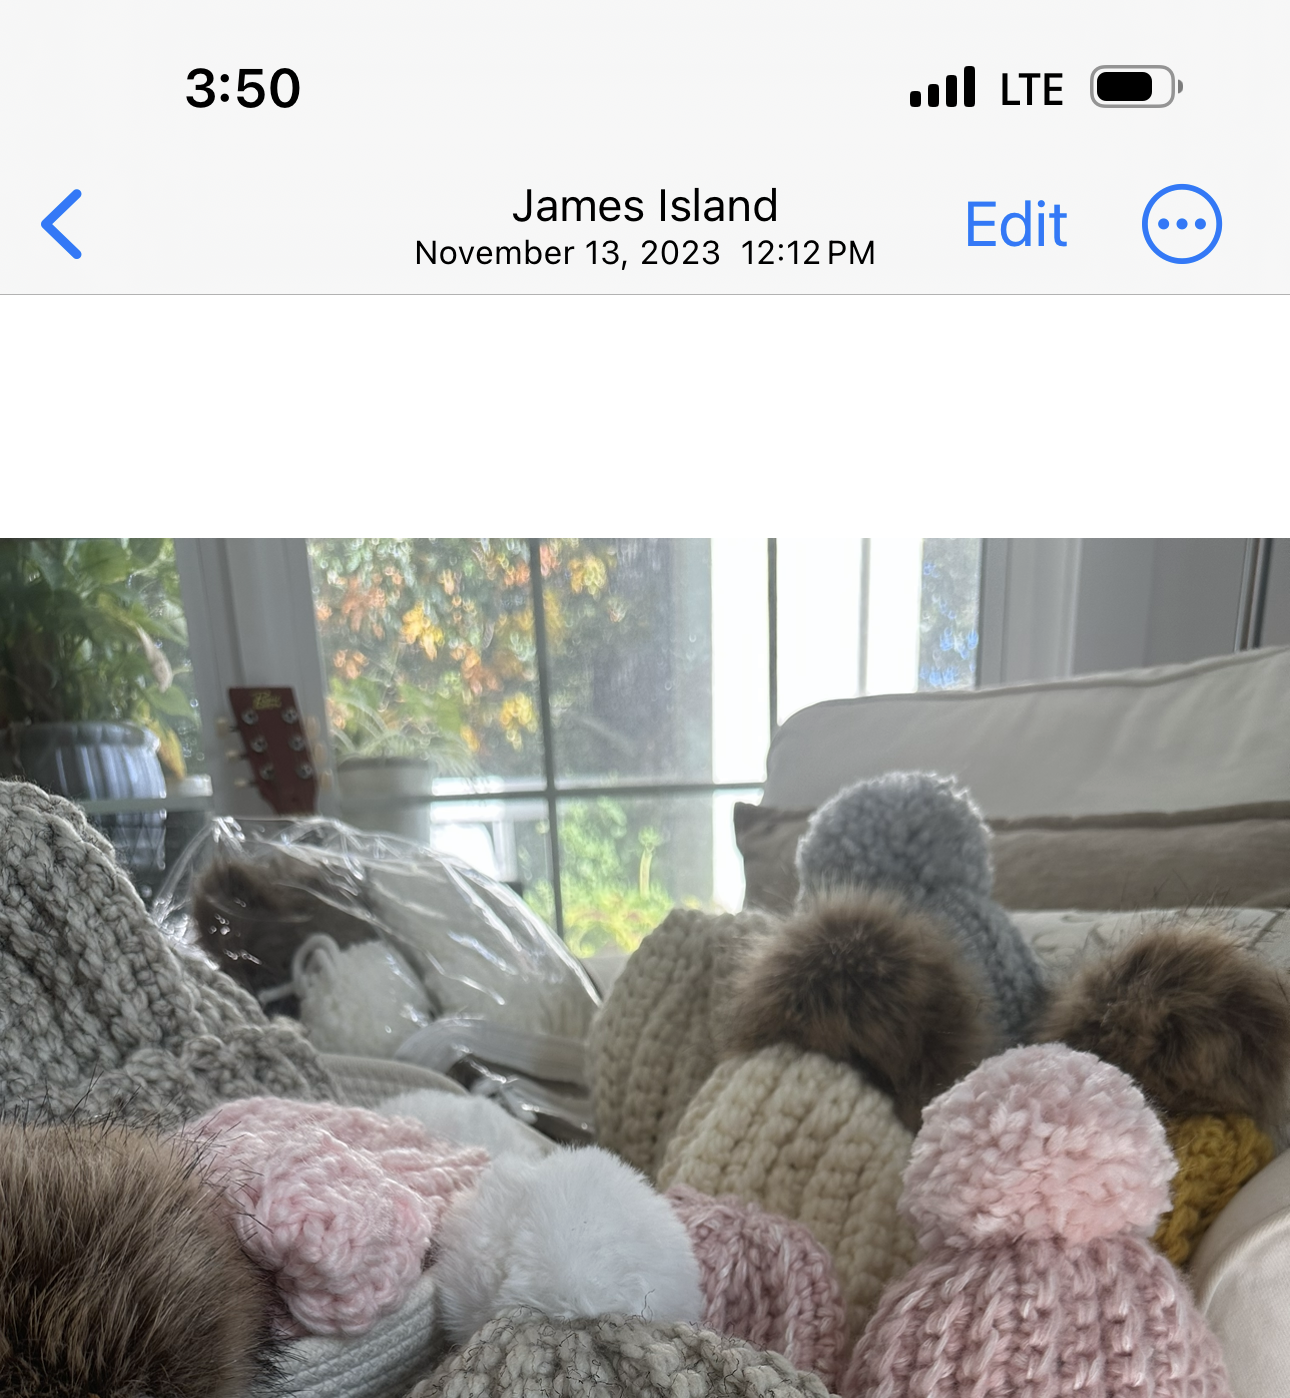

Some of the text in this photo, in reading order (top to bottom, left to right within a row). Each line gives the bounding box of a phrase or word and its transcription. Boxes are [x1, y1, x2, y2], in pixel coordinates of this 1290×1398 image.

[186, 68, 300, 108] 3:50
[1002, 73, 1063, 105] LTE
[513, 188, 776, 222] James Island
[968, 200, 1067, 247] Edit
[417, 239, 874, 270] November 13, 2023 12:12 PM
